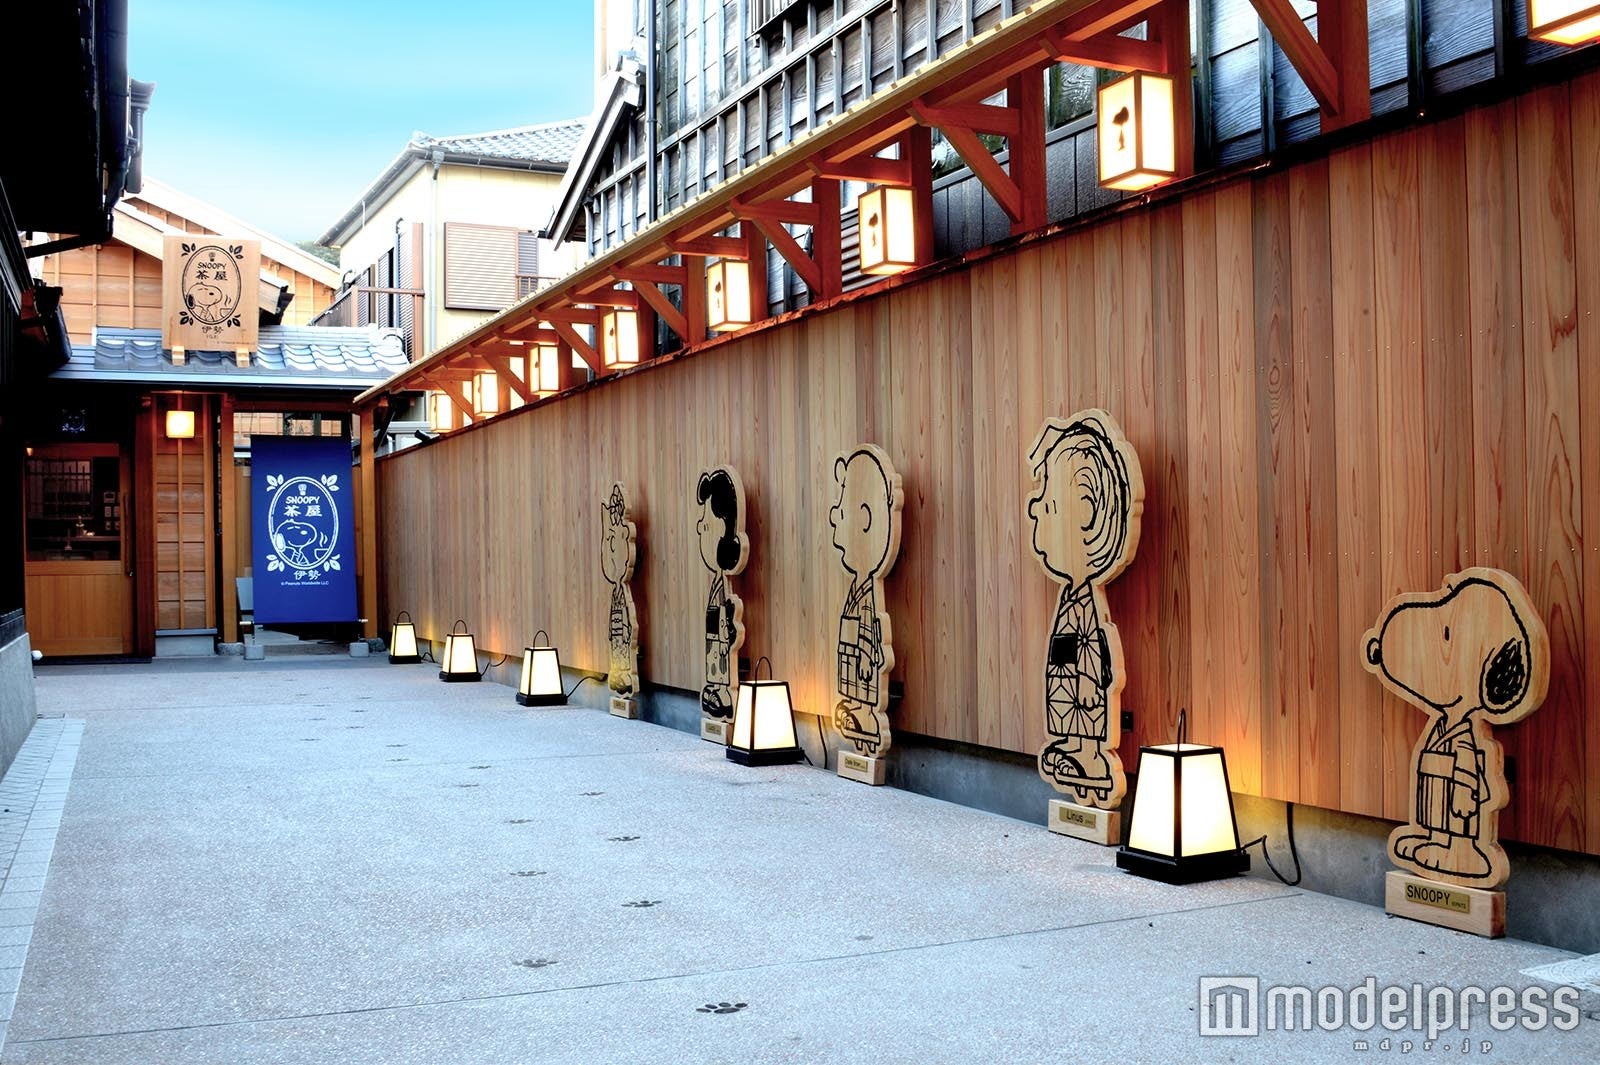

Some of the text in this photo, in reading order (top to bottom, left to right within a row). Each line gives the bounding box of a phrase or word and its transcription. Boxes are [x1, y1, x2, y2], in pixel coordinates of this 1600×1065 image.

[197, 262, 227, 270] SNOOPY
[195, 270, 228, 281] 茶屋
[285, 496, 320, 504] SNOOPY
[283, 505, 323, 517] 茶屋
[293, 569, 321, 580] 伊勢
[1407, 884, 1450, 905] SNOOPY
